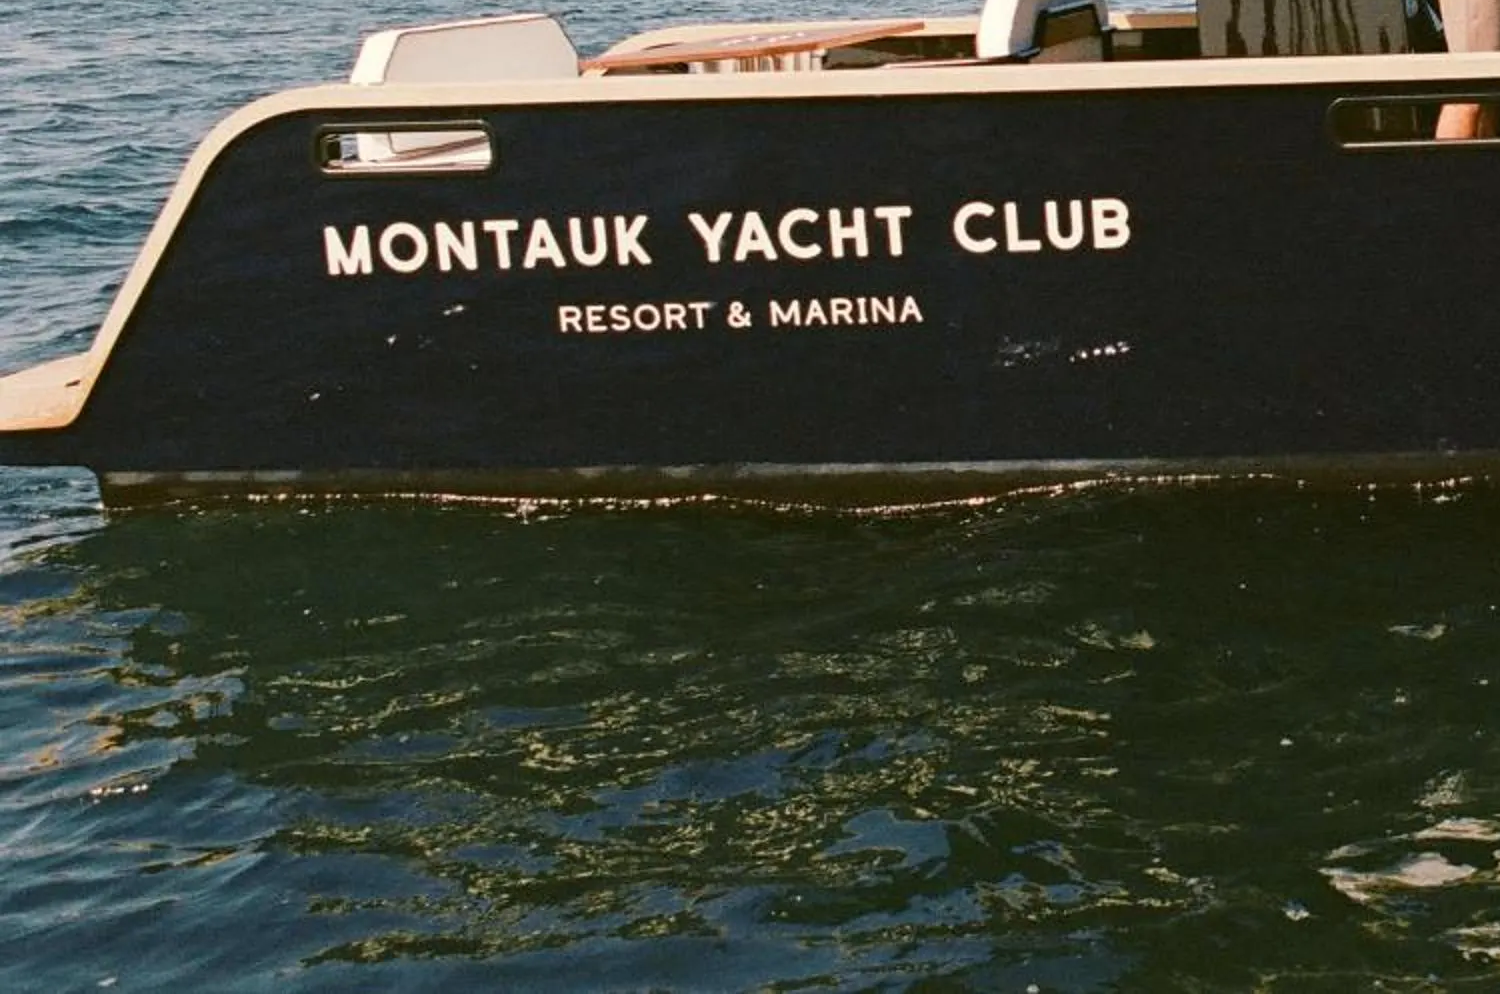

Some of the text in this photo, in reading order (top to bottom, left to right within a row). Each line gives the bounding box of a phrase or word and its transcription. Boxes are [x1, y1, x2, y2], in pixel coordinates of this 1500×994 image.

[323, 197, 1132, 276] MONTAUK YACHT CLUB
[558, 295, 924, 333] RESORT & MARINA
